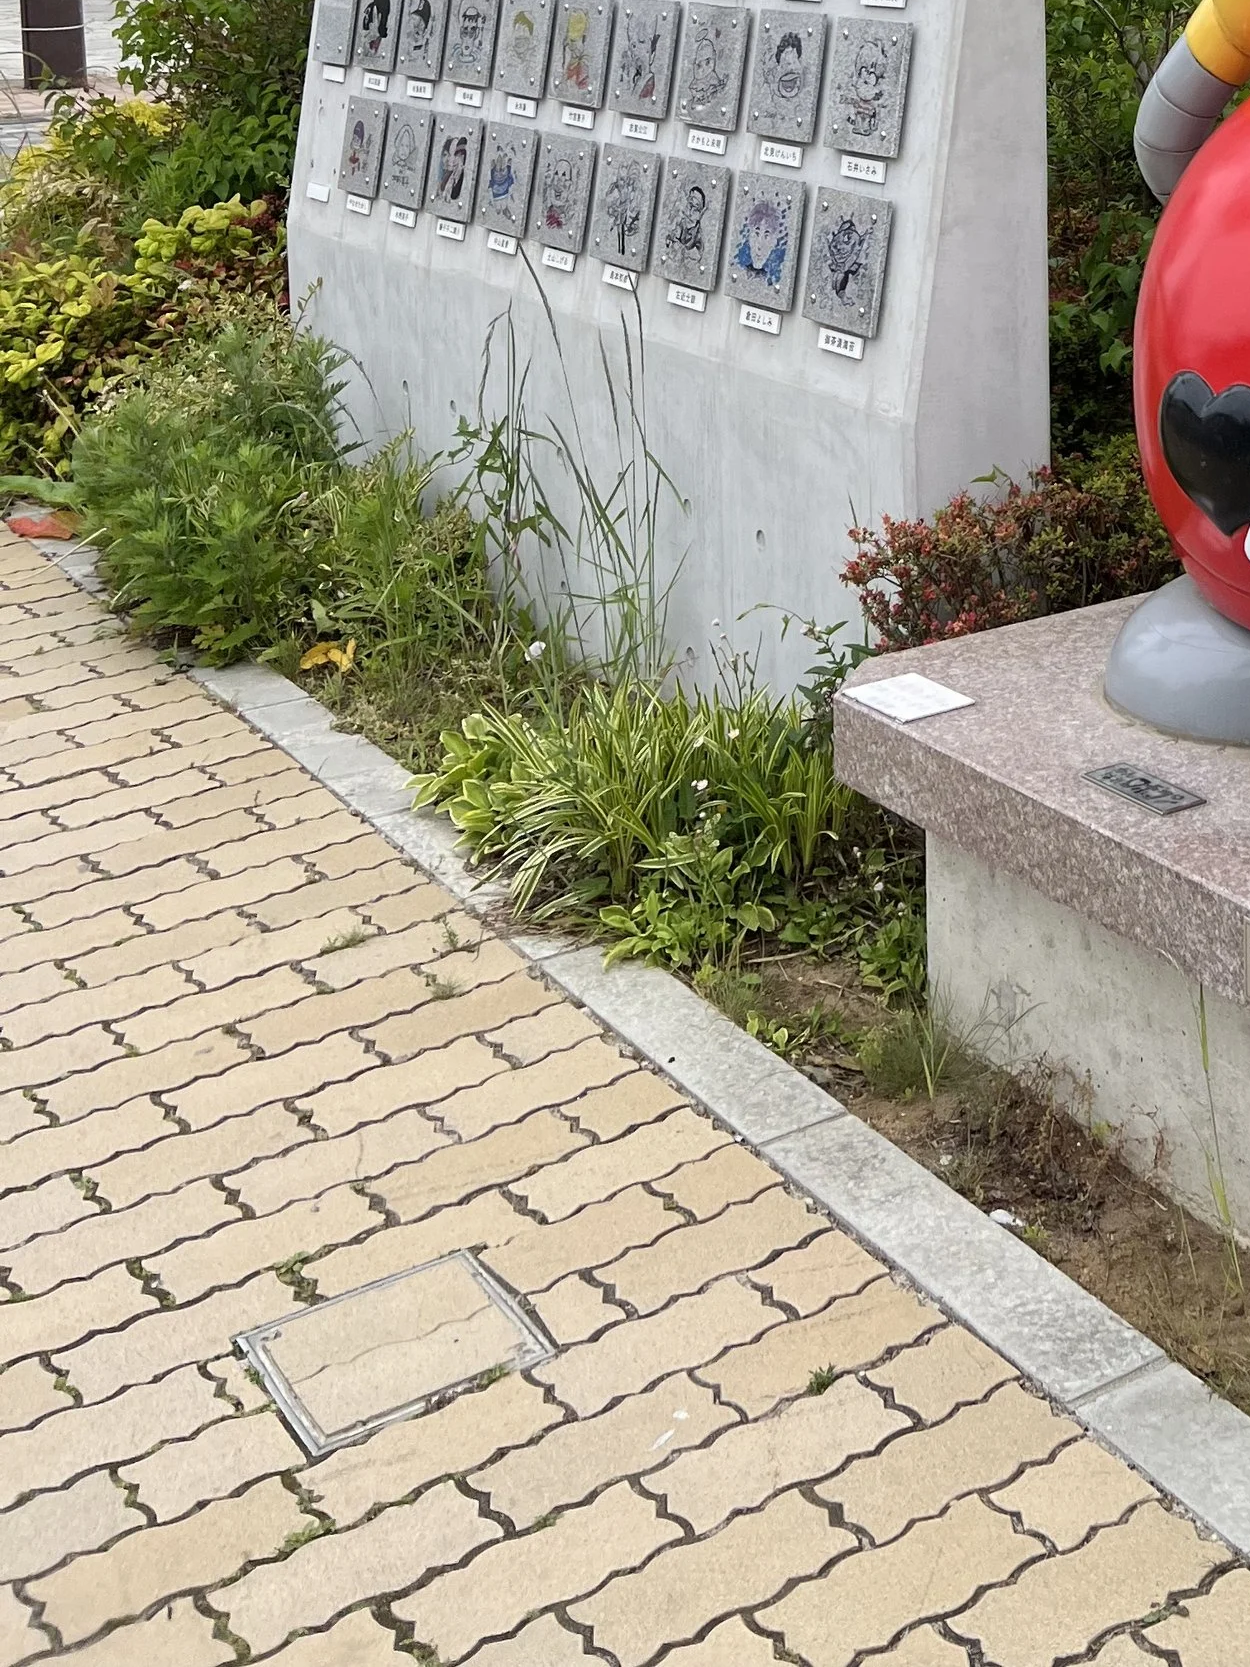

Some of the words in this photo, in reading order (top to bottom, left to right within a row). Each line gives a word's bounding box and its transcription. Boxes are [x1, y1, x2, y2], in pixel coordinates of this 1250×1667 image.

[764, 147, 797, 161] 北見けんいち
[847, 161, 877, 176] 石井いさみ
